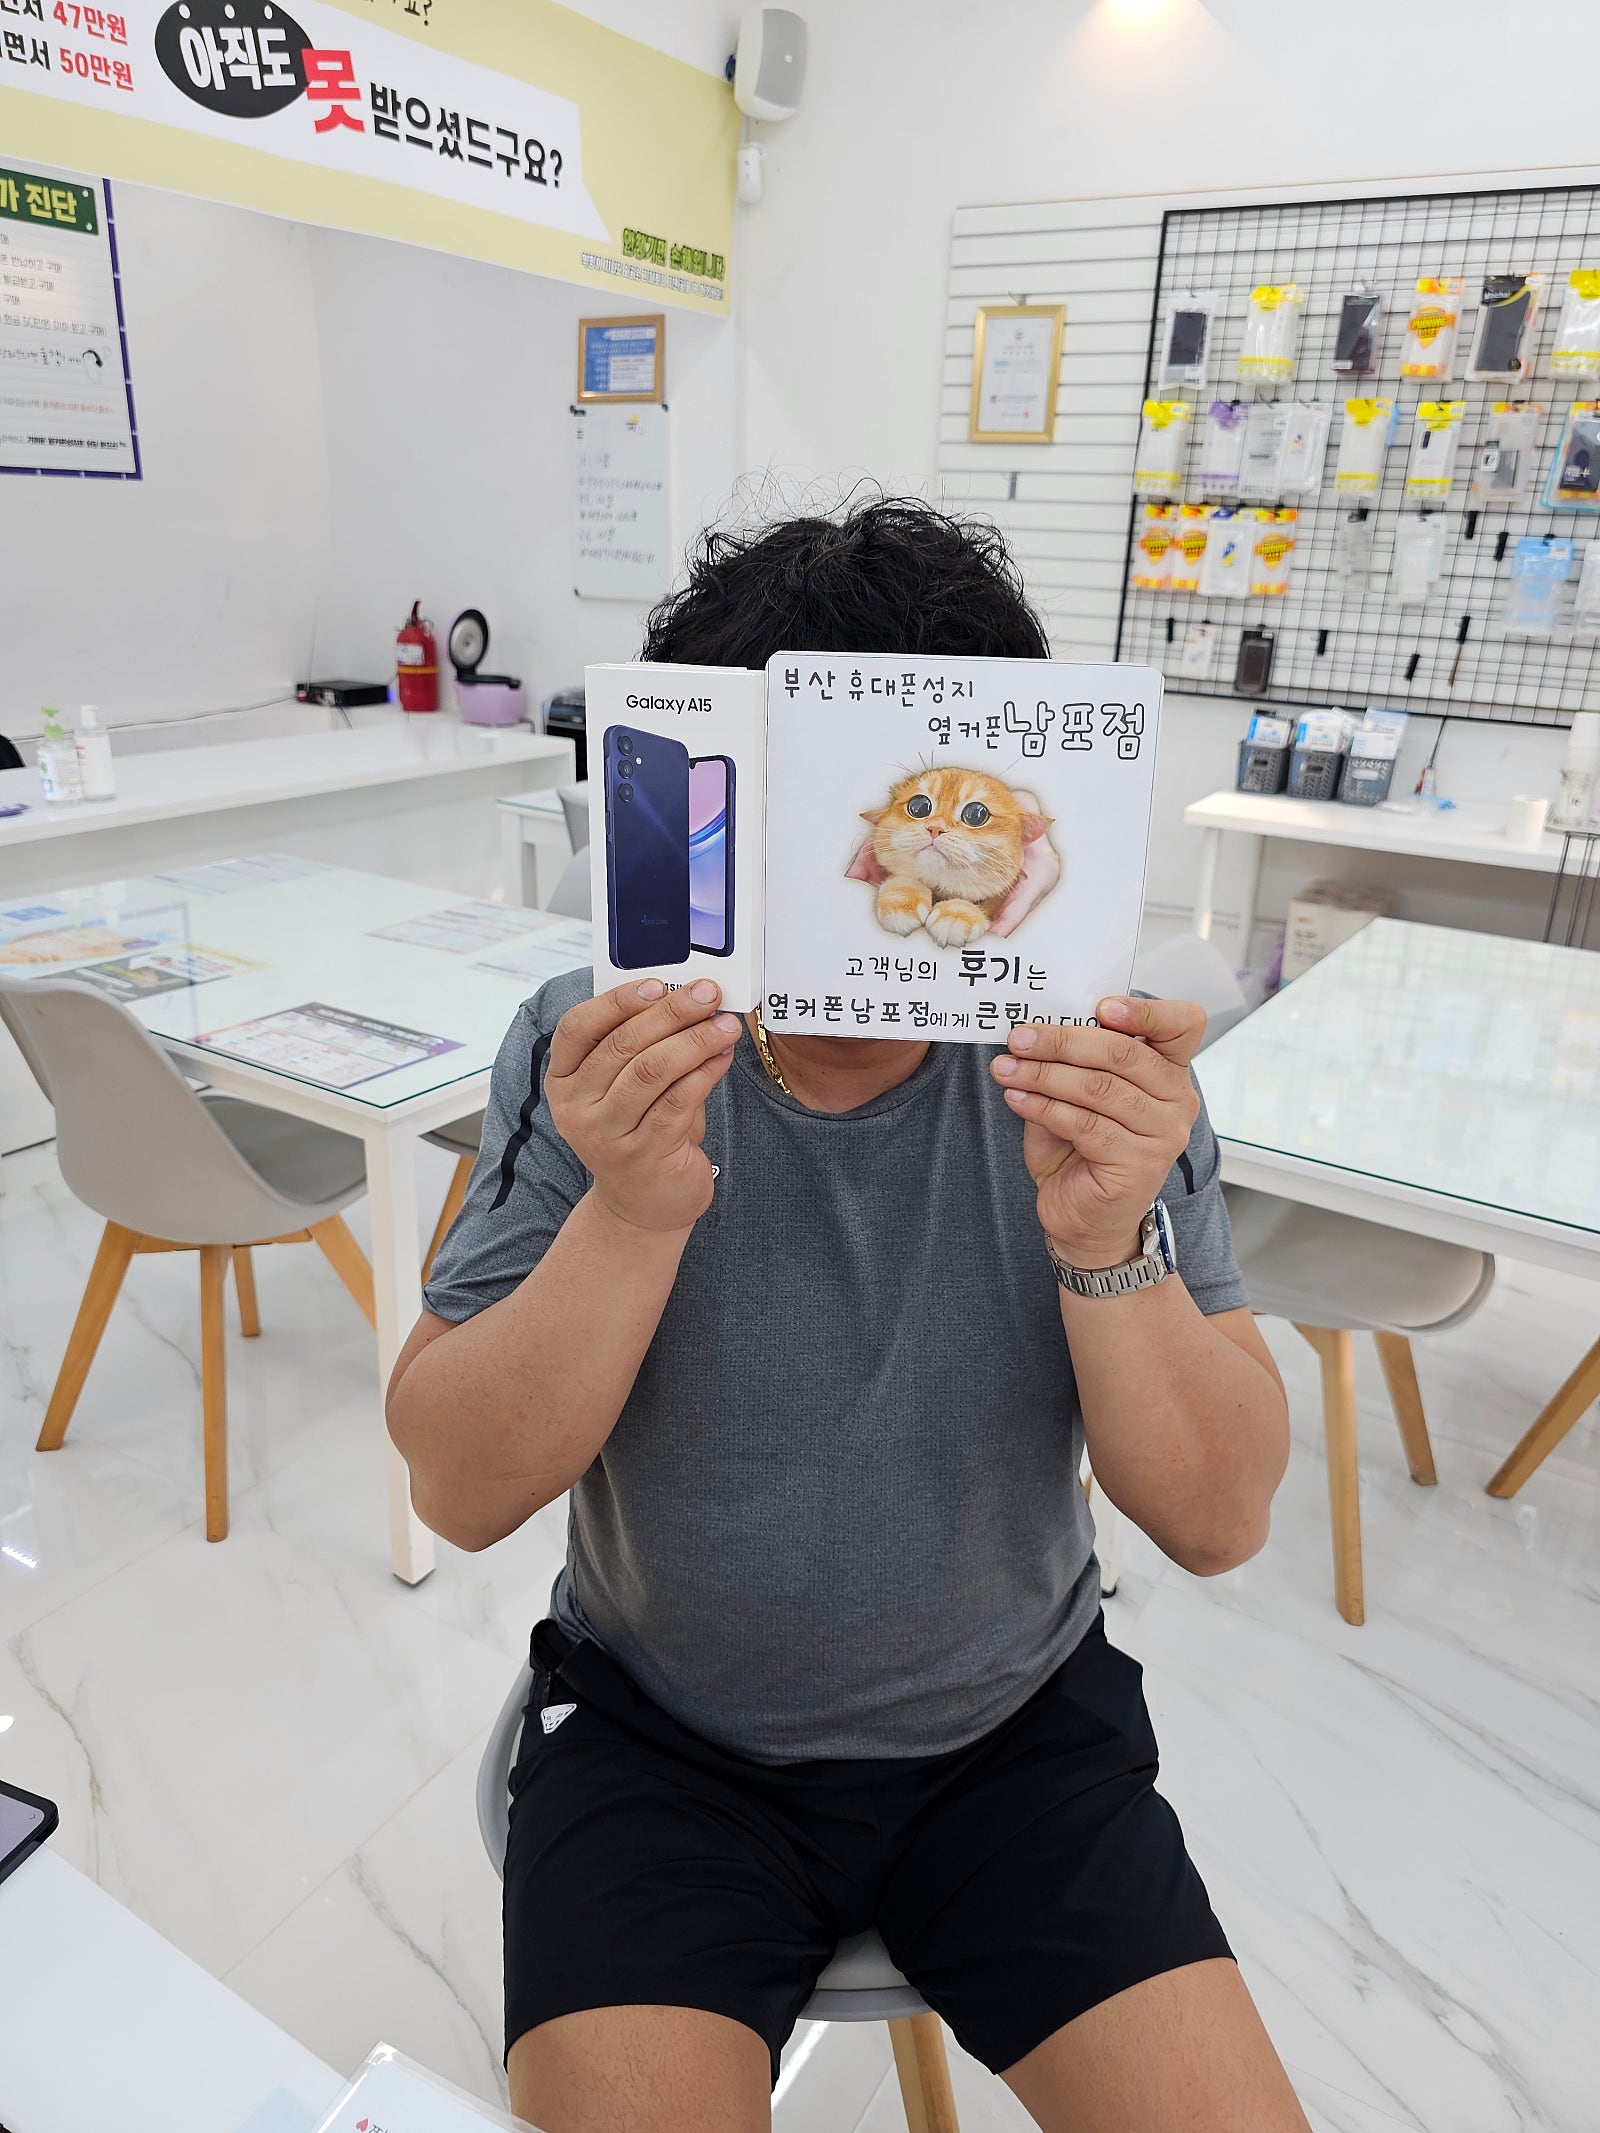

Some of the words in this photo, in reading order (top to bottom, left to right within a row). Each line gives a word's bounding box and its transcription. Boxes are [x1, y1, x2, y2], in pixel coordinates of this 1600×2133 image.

[53, 1, 128, 45] 47만원
[60, 47, 134, 91] 50만원
[179, 26, 296, 91] 아직도
[301, 48, 365, 133] 못
[370, 82, 563, 188] 받으셨드구요?
[24, 182, 77, 224] 진단
[625, 694, 685, 714] Galaxy
[687, 697, 712, 713] A15
[784, 667, 836, 701] 부산
[845, 956, 938, 983] 고객님의
